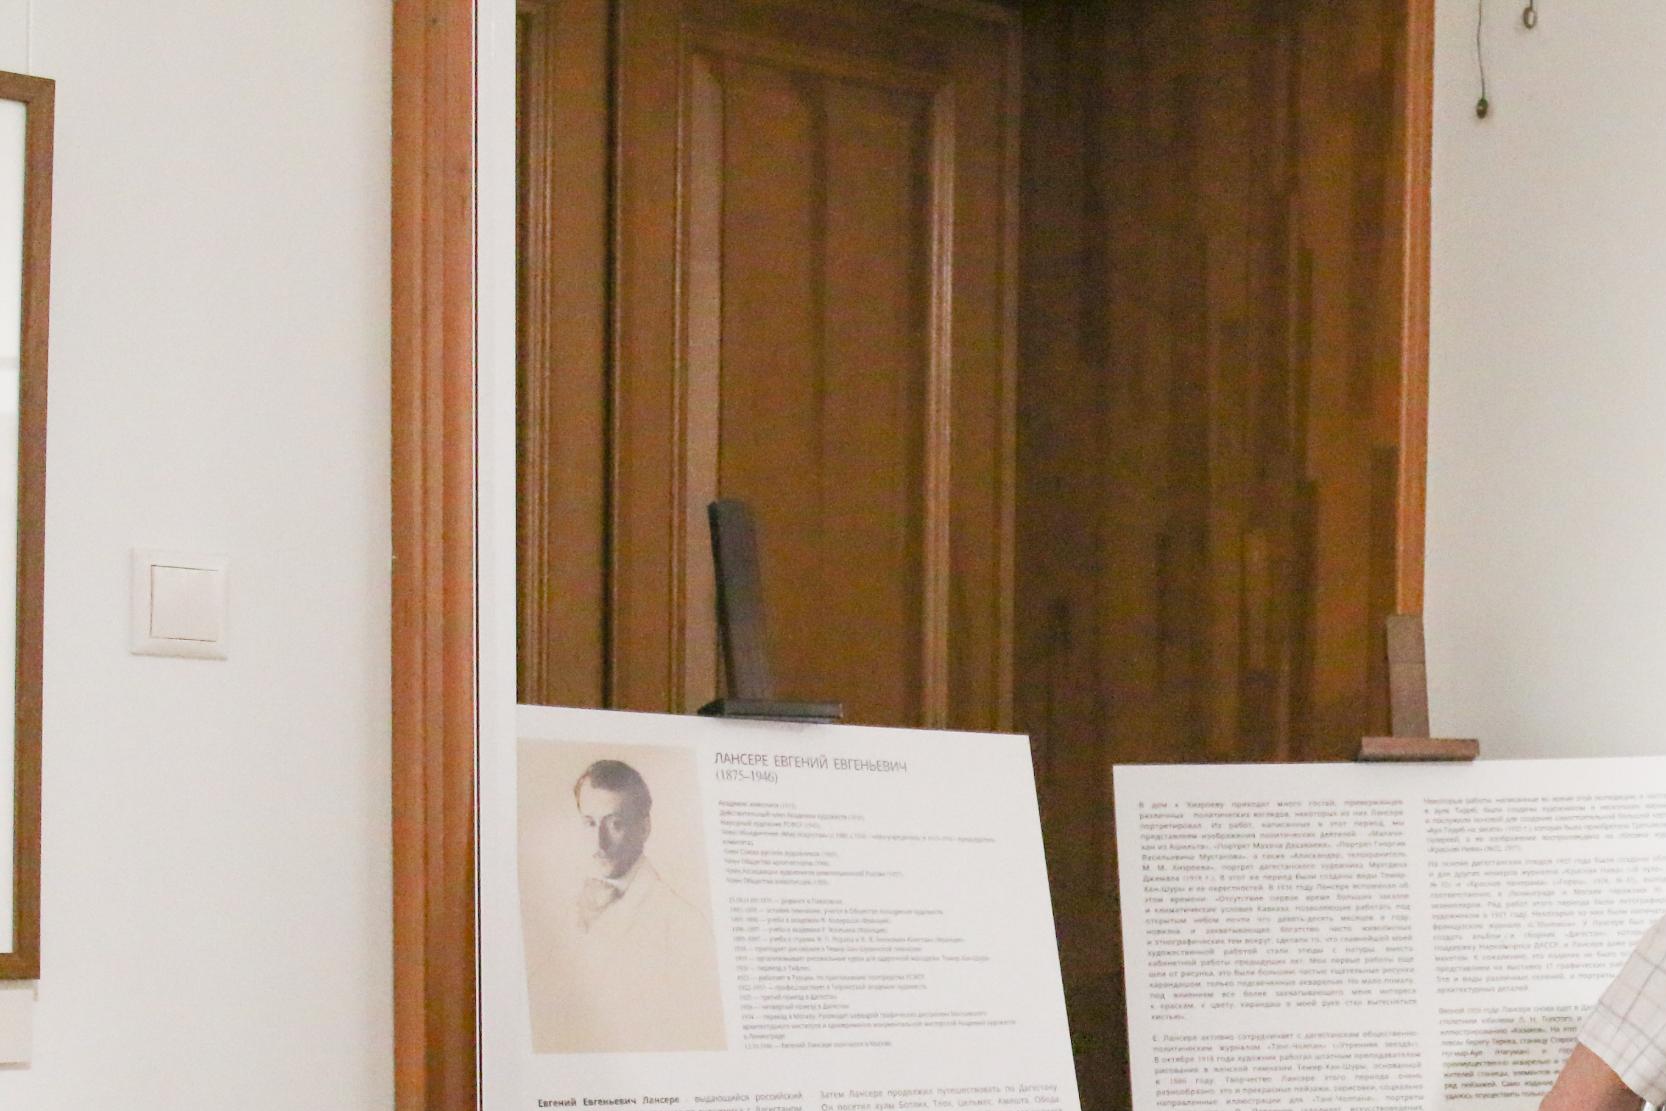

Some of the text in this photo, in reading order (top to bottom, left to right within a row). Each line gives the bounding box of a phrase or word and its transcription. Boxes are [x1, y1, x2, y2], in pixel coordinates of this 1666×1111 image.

[714, 752, 908, 773] ЛАНСЕРЕ ЕВГЕНИЙ ЕВГЕНЬЕВИЧ
[537, 1097, 578, 1108] Евгений
[582, 1097, 637, 1107] Евгеньевич
[642, 1095, 680, 1106] Лансере
[755, 1091, 803, 1103] российский
